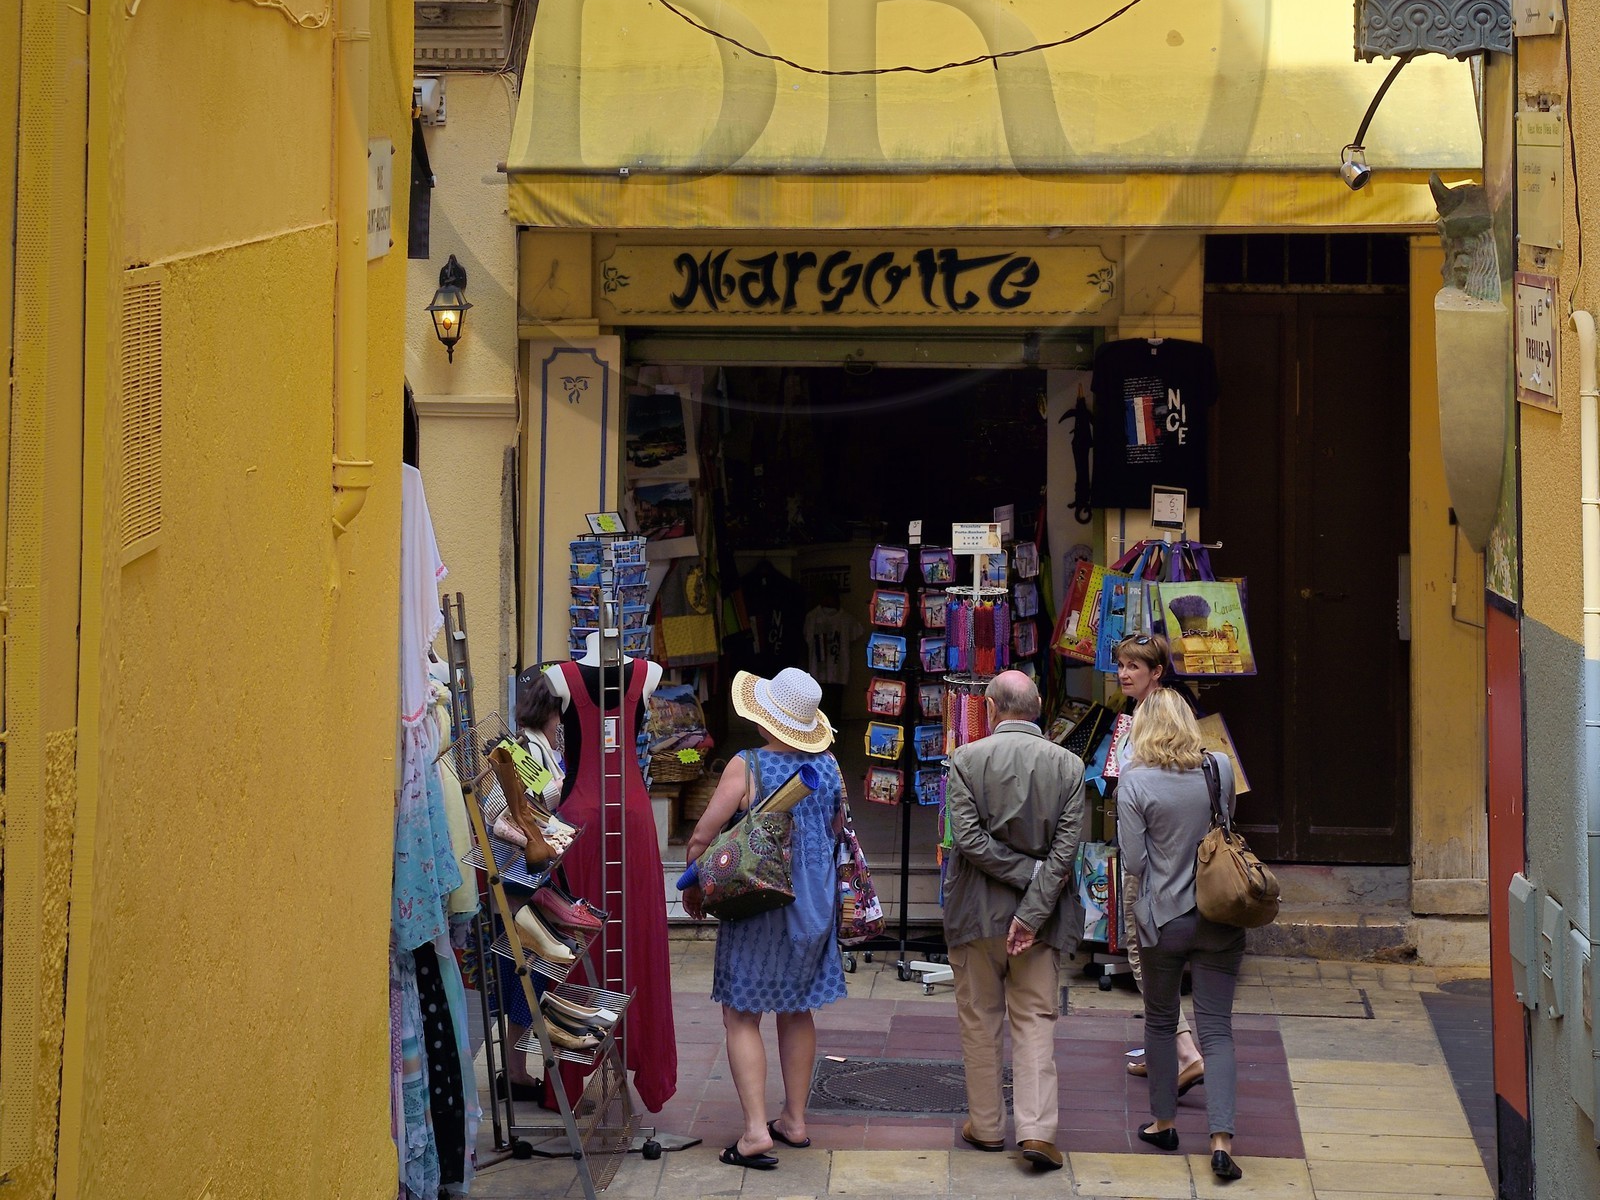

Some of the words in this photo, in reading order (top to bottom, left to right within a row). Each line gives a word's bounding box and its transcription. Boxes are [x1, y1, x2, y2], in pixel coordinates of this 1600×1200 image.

[670, 246, 1039, 312] Margotte
[1531, 304, 1538, 326] LA
[1525, 337, 1545, 363] TREILLE
